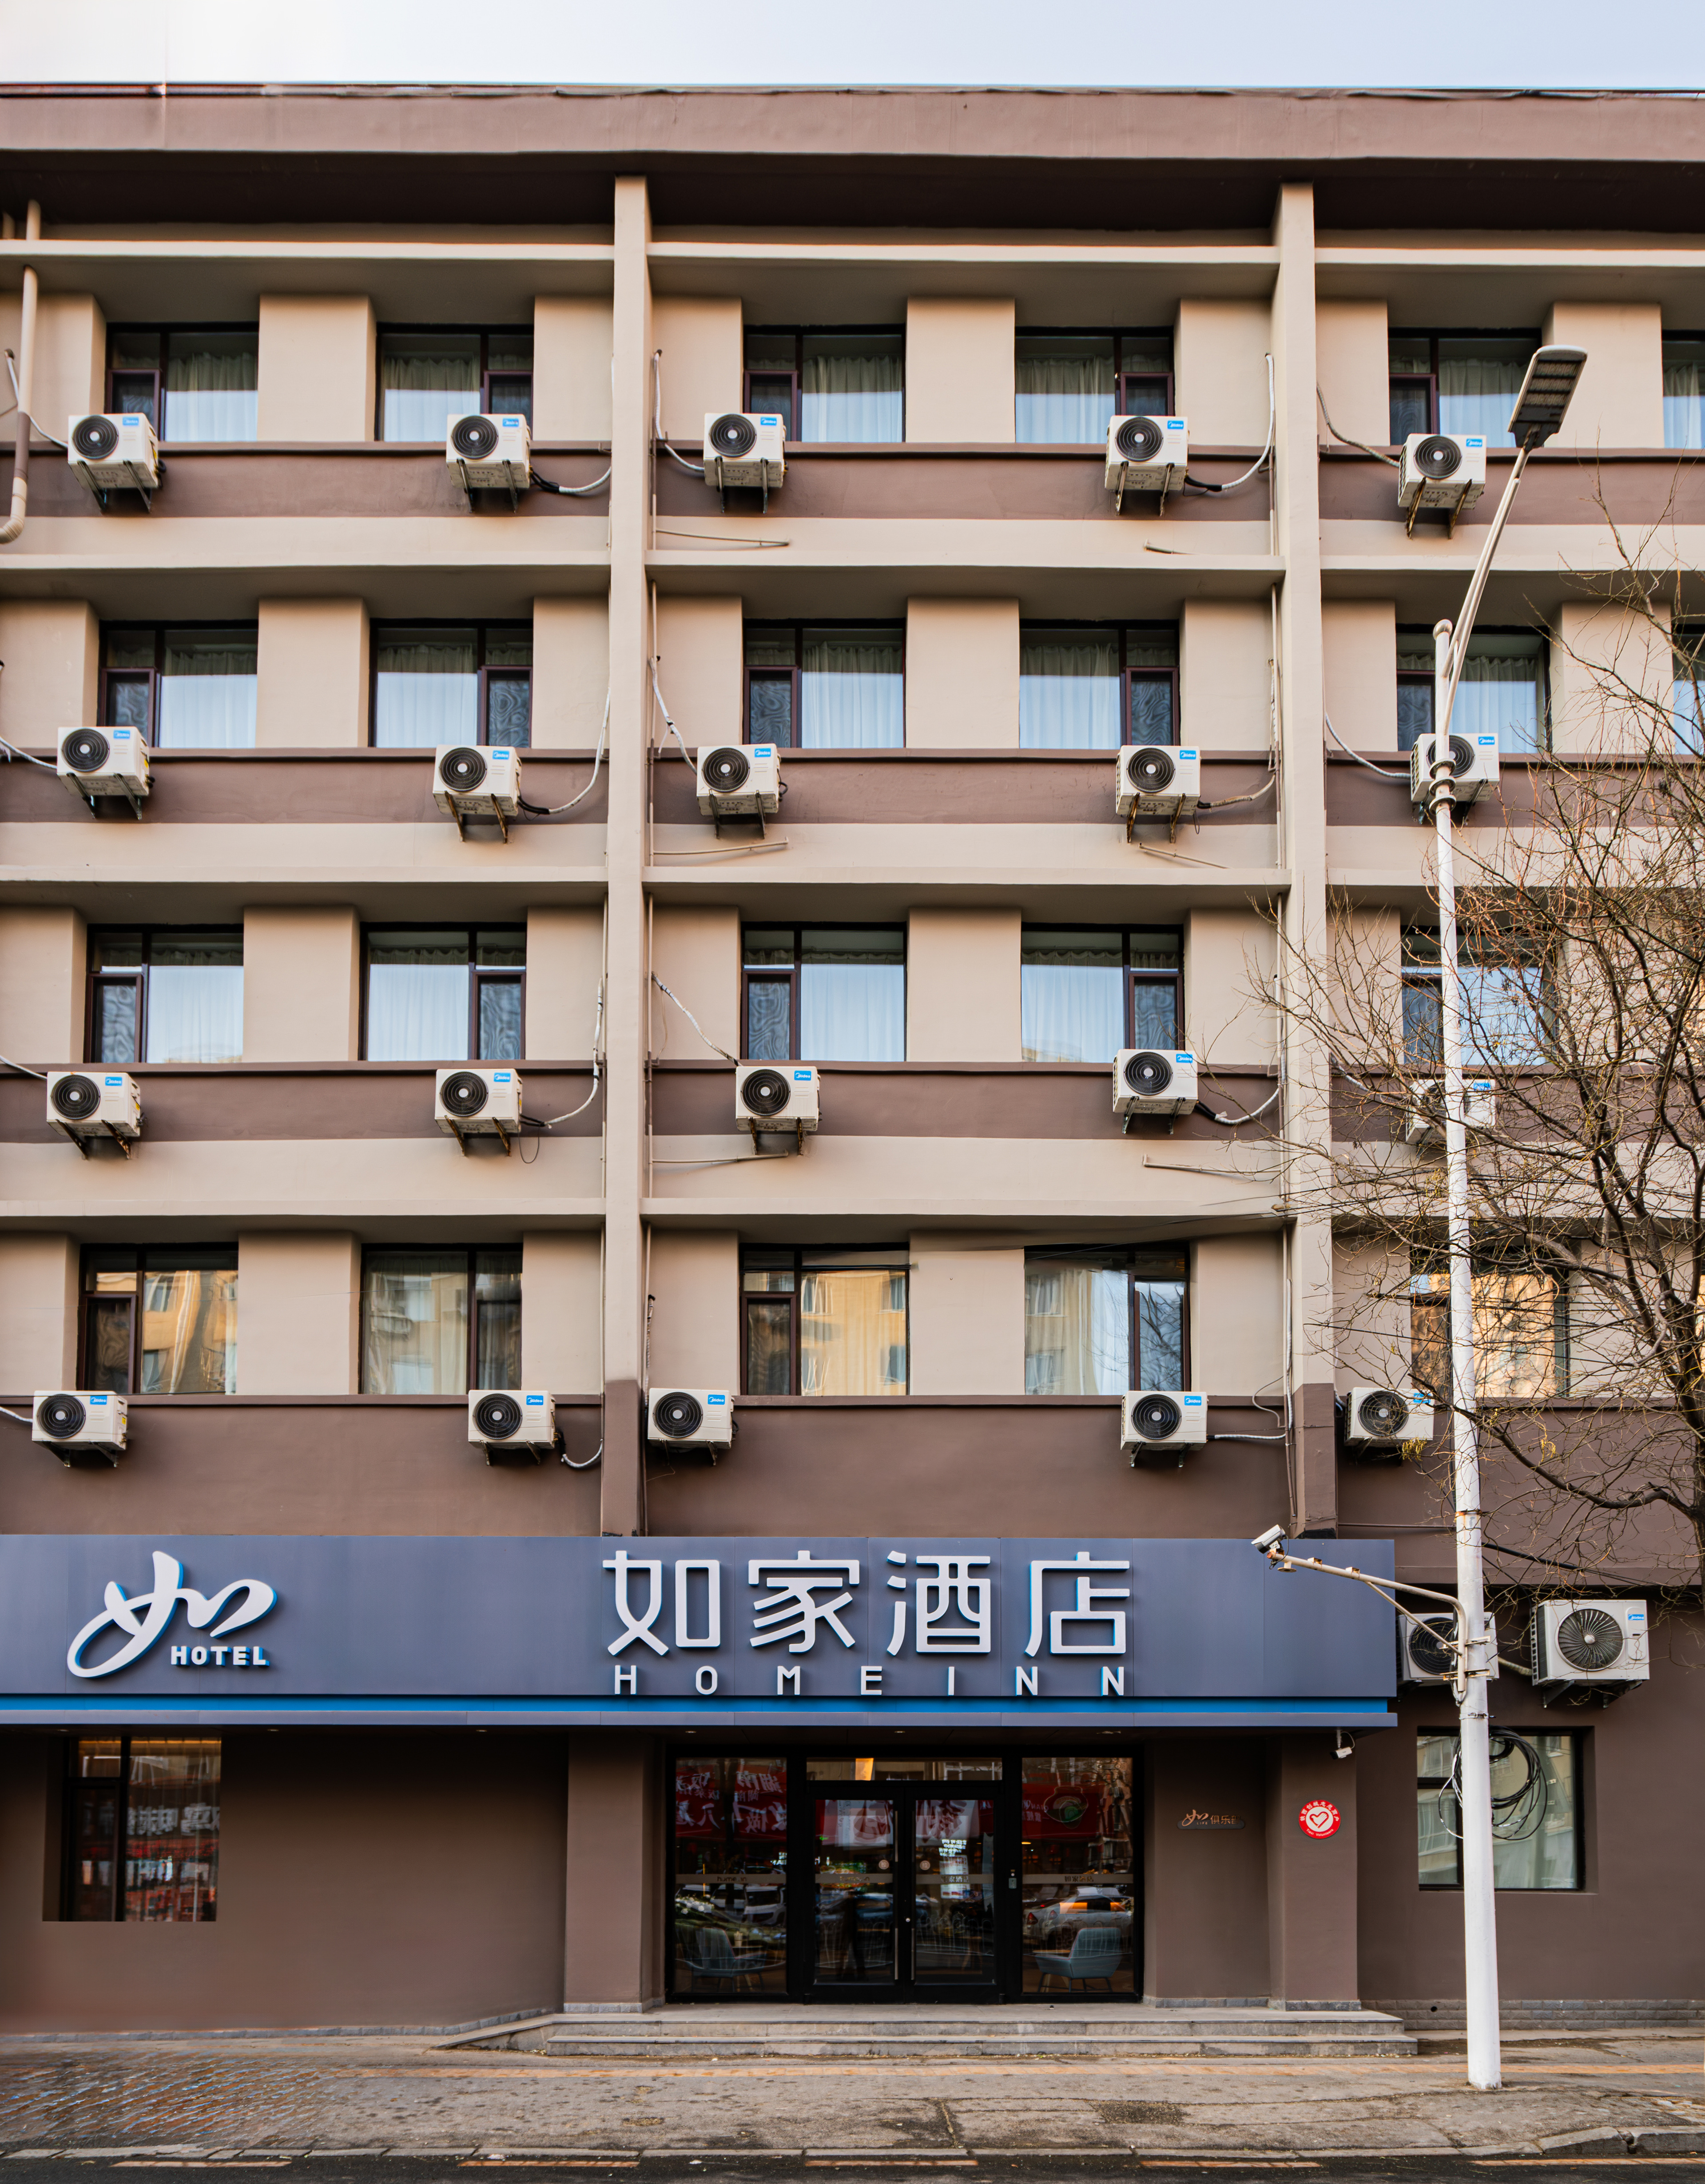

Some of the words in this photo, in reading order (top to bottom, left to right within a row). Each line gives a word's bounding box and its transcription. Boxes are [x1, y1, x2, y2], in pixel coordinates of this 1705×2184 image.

[603, 1550, 1130, 1657] 如家酒店
[171, 1646, 270, 1667] HOTEL
[1210, 1815, 1240, 1825] 俱乐部
